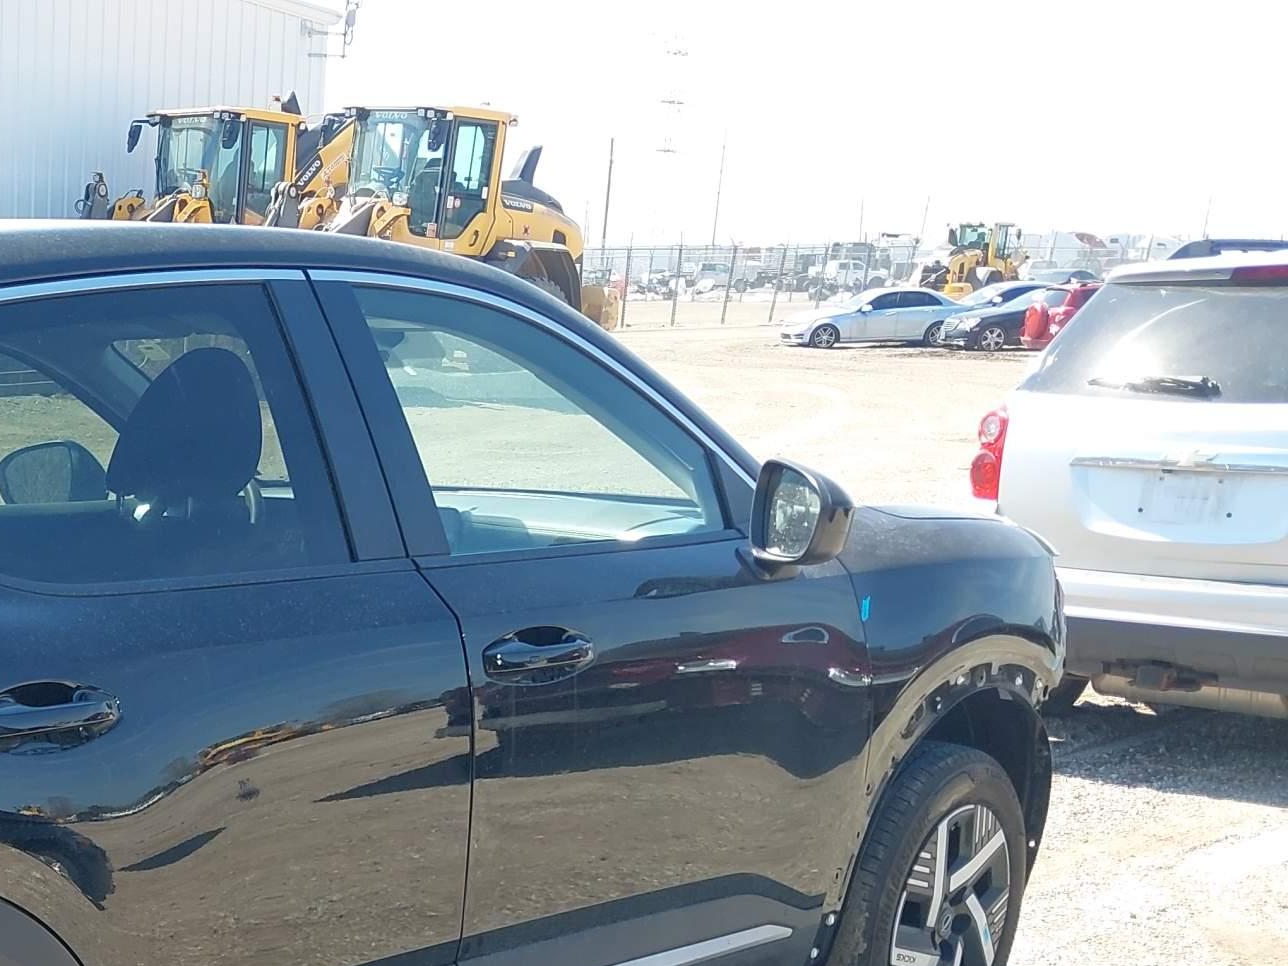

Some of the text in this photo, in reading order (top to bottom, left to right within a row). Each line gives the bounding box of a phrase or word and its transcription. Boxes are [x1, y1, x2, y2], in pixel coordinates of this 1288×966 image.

[376, 112, 408, 120] VOLVO
[297, 160, 321, 186] VOLVO
[504, 200, 532, 210] VOLVO
